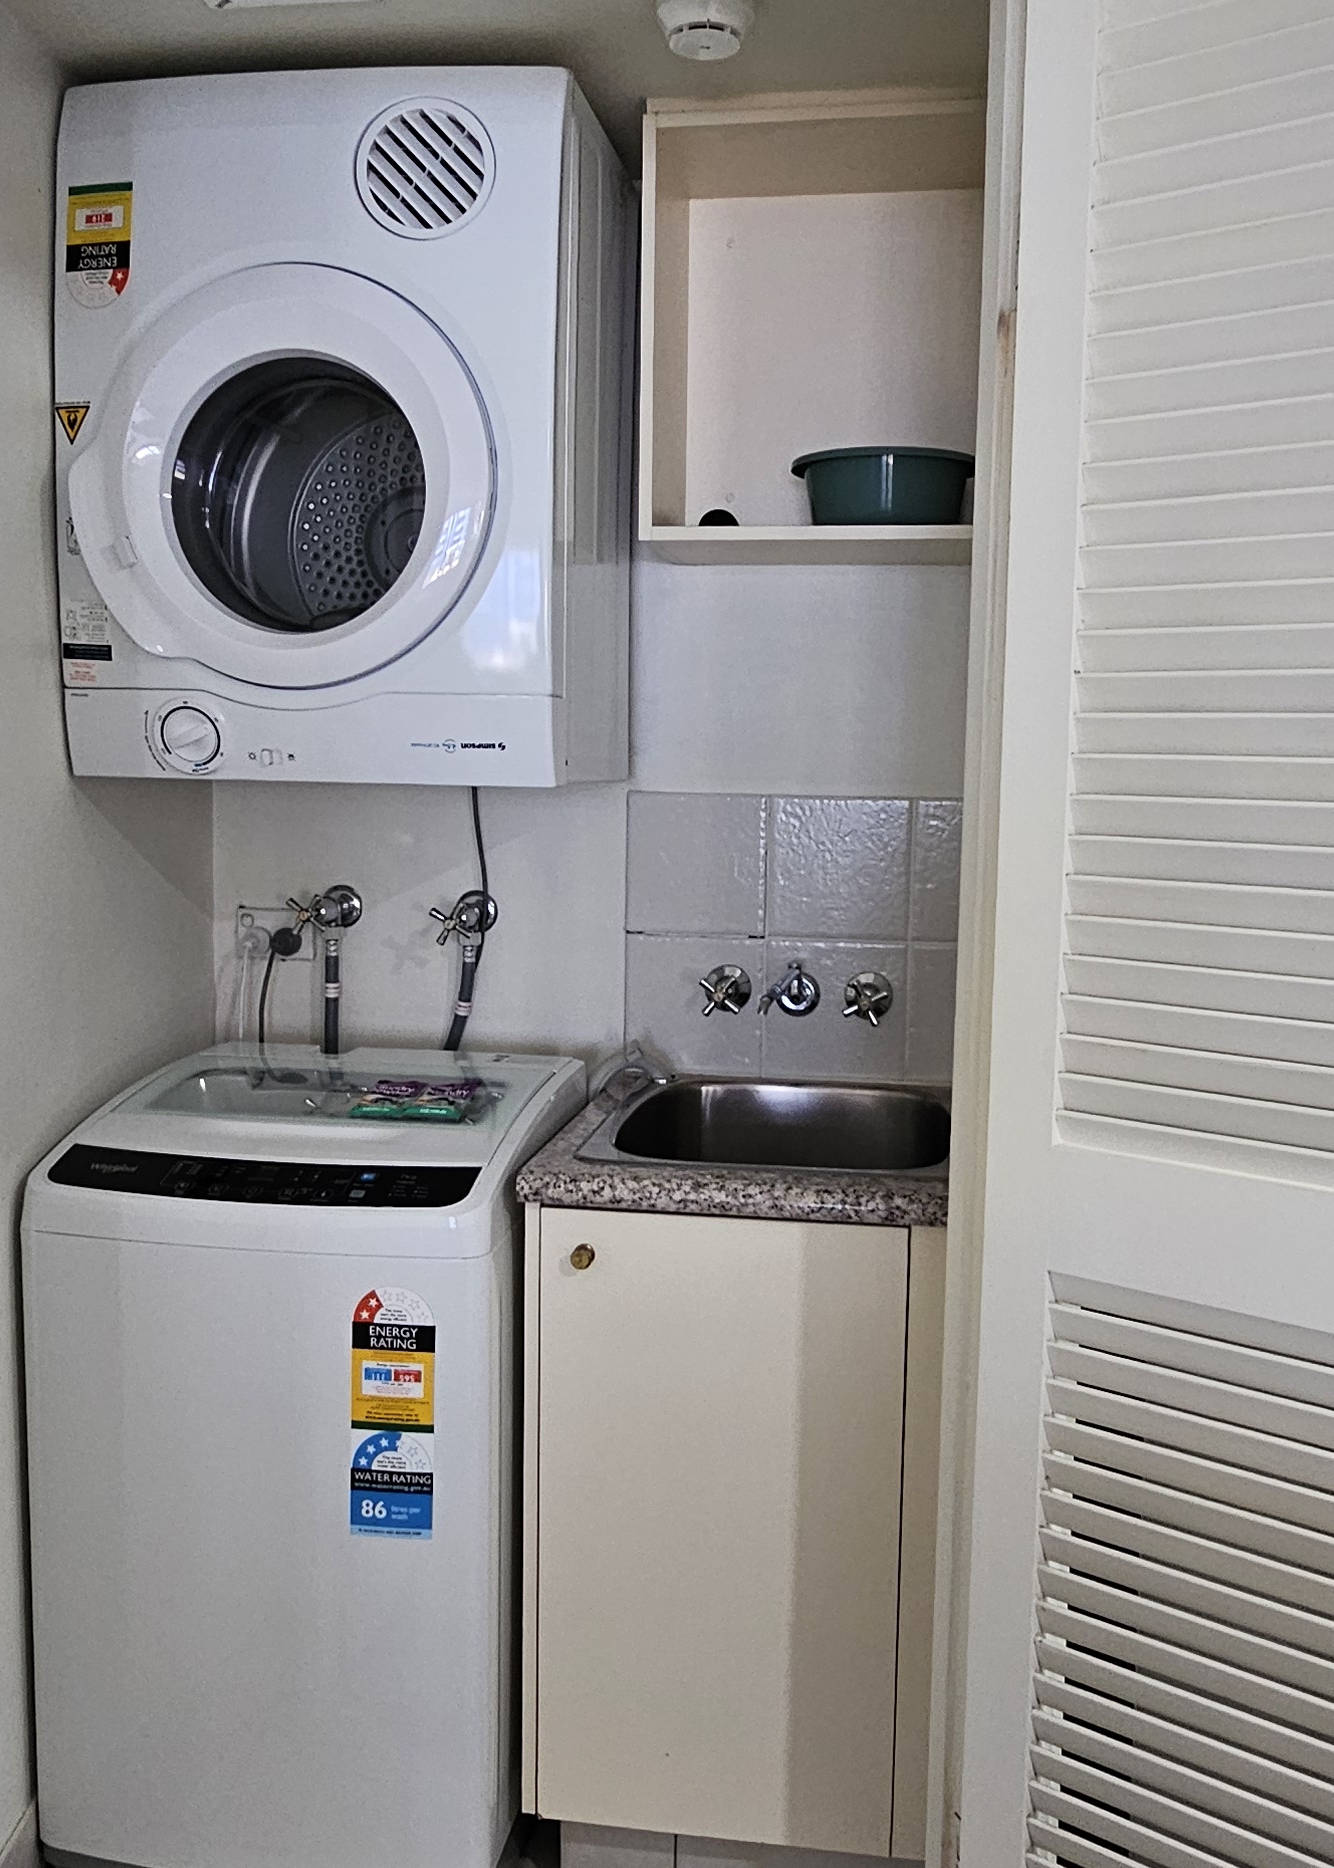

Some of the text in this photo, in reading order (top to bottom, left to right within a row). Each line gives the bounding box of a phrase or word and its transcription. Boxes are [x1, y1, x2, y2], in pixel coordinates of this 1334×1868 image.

[80, 244, 117, 256] RATING
[78, 256, 118, 269] ENERGY
[369, 1325, 418, 1339] ENERGY
[370, 1337, 417, 1350] RATING
[354, 1471, 432, 1485] WATER RATING
[361, 1499, 387, 1519] 86
